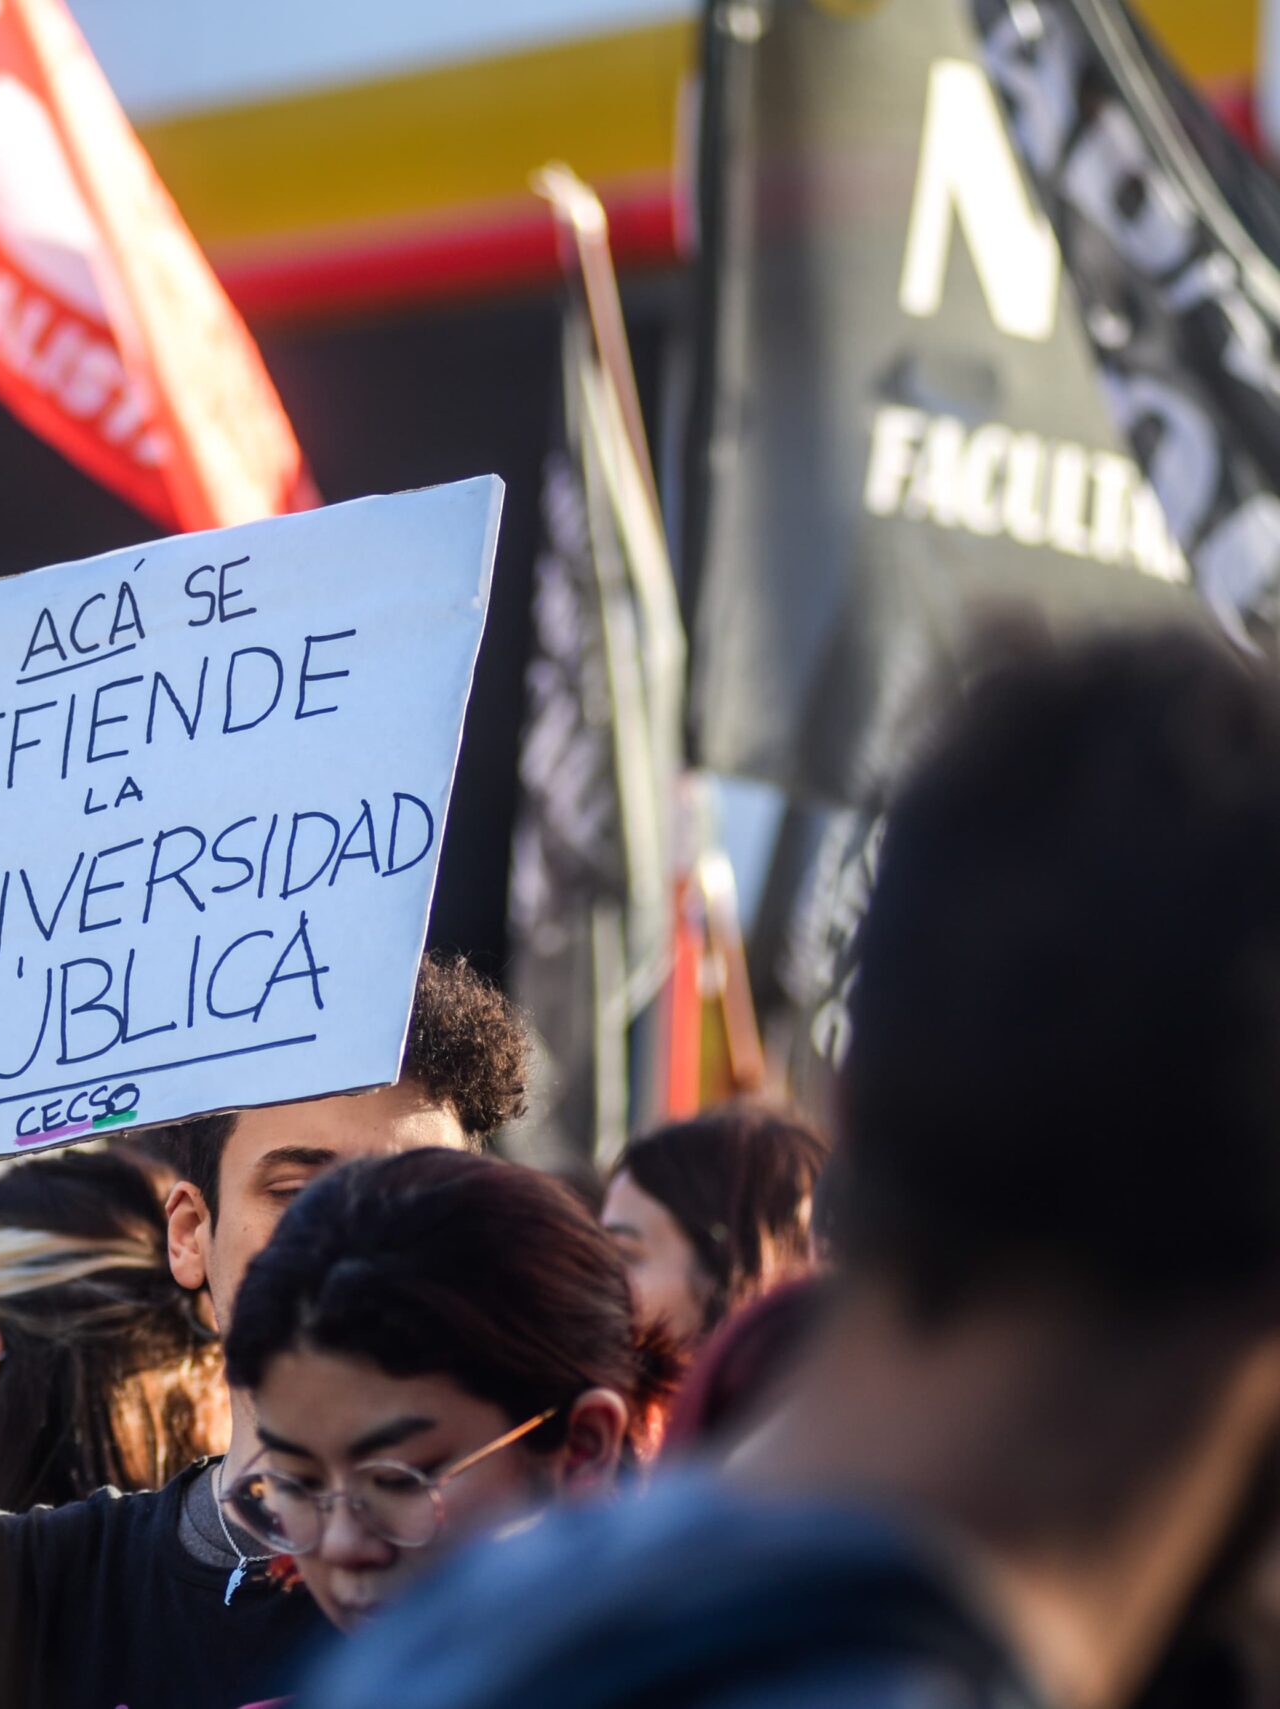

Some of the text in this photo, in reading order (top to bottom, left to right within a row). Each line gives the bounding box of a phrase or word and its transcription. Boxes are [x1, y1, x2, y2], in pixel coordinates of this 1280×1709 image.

[21, 556, 257, 672] ACÁ SE
[83, 776, 144, 815] LA
[16, 1083, 140, 1136] CECSO
